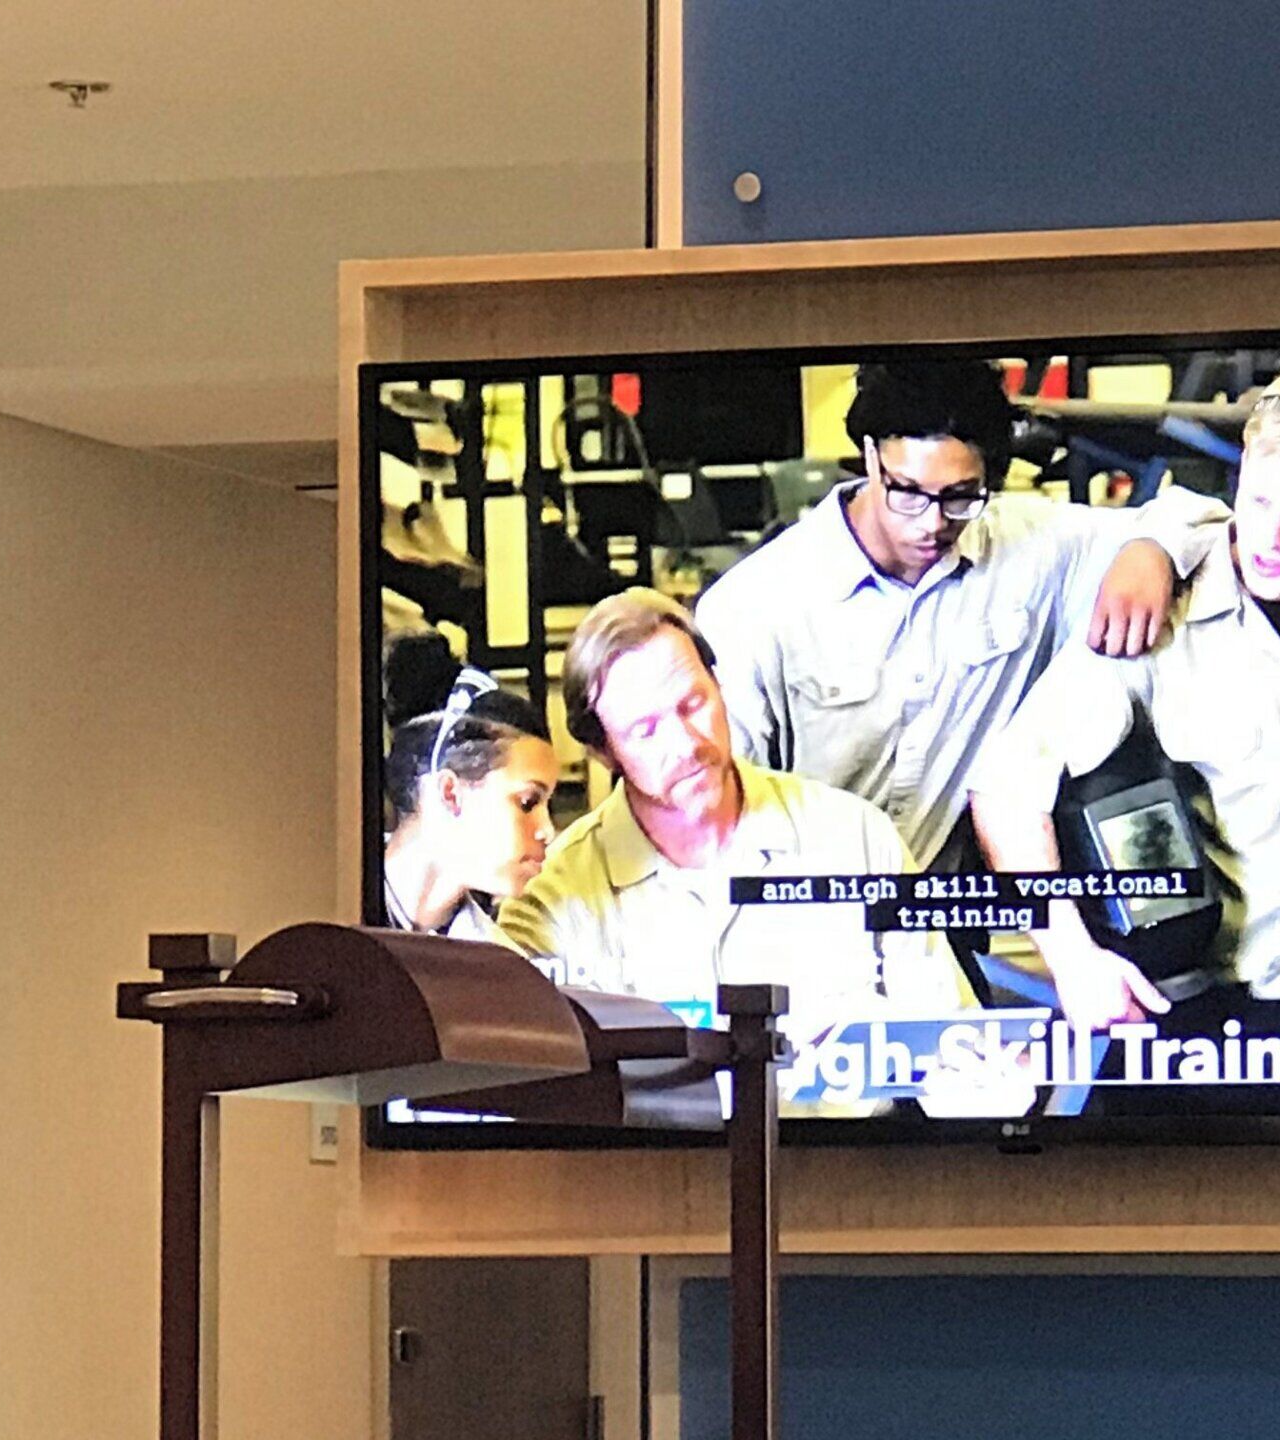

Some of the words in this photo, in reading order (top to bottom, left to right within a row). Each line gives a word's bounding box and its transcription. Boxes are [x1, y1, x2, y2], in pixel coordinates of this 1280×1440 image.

[761, 876, 814, 901] and
[828, 876, 898, 904] high
[914, 874, 999, 900] skill
[1015, 872, 1188, 898] vocational
[897, 904, 1034, 929] training
[777, 1019, 1092, 1104] gh-Skill
